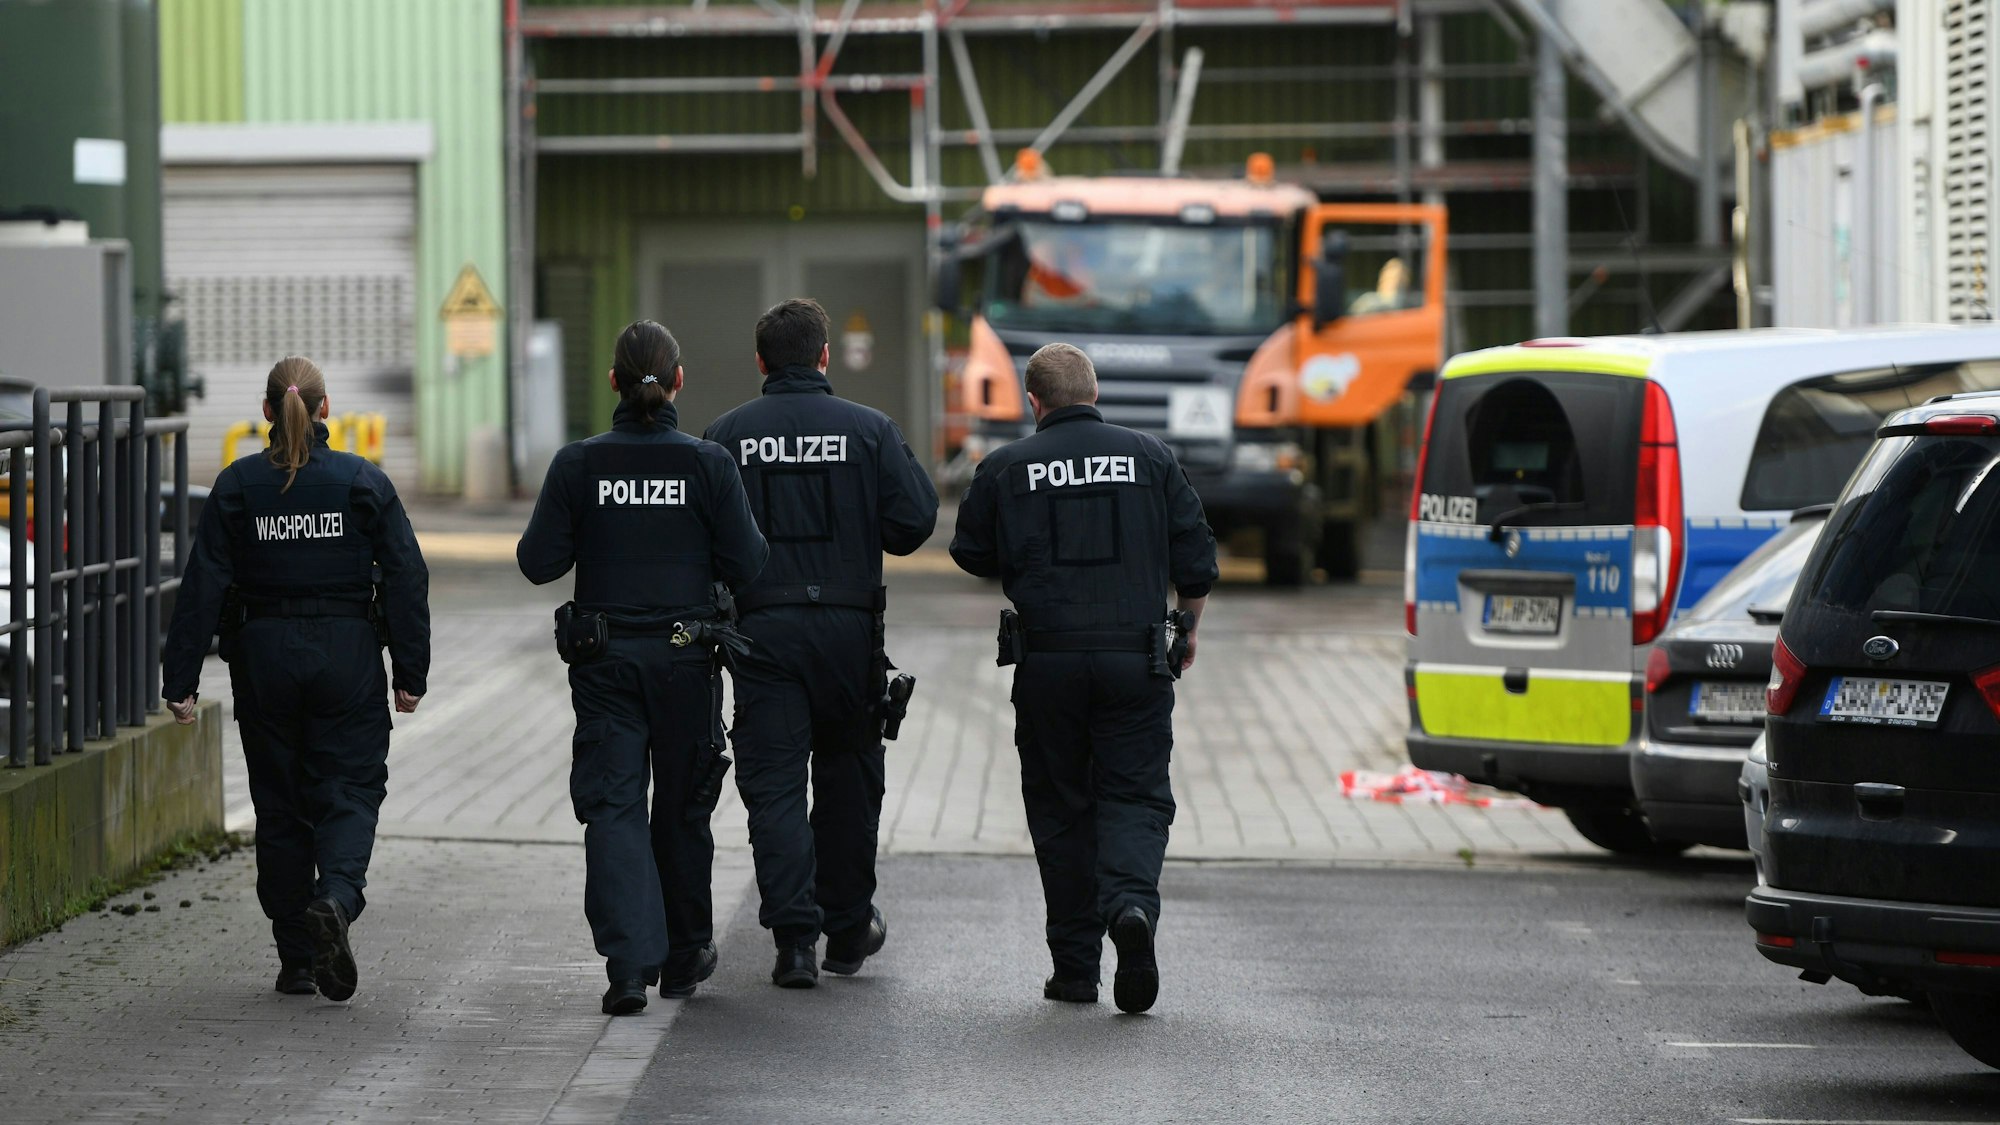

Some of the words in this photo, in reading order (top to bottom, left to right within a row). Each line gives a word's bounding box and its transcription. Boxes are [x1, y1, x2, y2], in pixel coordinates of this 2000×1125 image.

[740, 435, 848, 466] POLIZEI
[1027, 455, 1136, 491] POLIZEI
[598, 479, 686, 505] POLIZEI
[1420, 494, 1478, 524] POLIZEI
[255, 512, 344, 541] WACHPOLIZEI
[1588, 565, 1621, 594] 110
